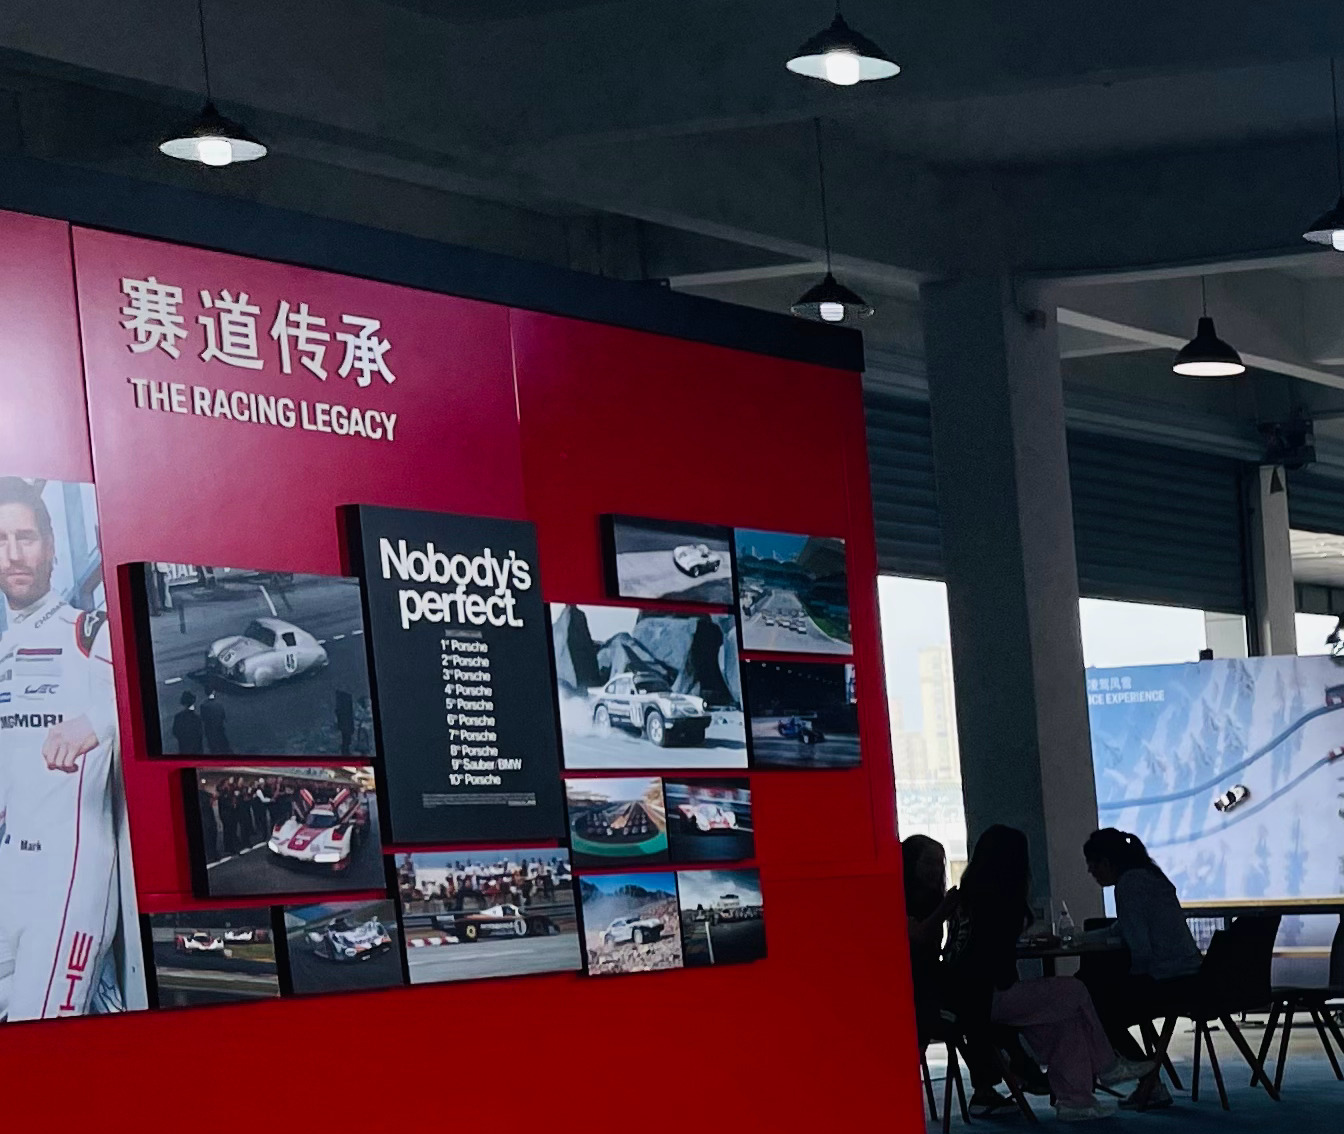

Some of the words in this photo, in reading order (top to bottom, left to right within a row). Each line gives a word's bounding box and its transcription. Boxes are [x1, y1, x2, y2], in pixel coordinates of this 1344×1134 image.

[119, 276, 397, 388] 赛道传承
[129, 376, 187, 414] THE
[194, 385, 296, 429] RACING
[300, 400, 398, 442] LEGACY
[398, 584, 524, 630] perfect.
[451, 640, 488, 653] Porsche
[453, 655, 489, 667] Porsche
[454, 669, 491, 682] Porsche
[455, 684, 493, 697] Porsche
[1105, 689, 1165, 704] EXPERIENCE
[457, 698, 494, 711] Porsche
[458, 714, 495, 726] Porsche
[460, 729, 497, 741] Porsche
[461, 744, 499, 756] Porsche
[464, 773, 501, 786] Porsche
